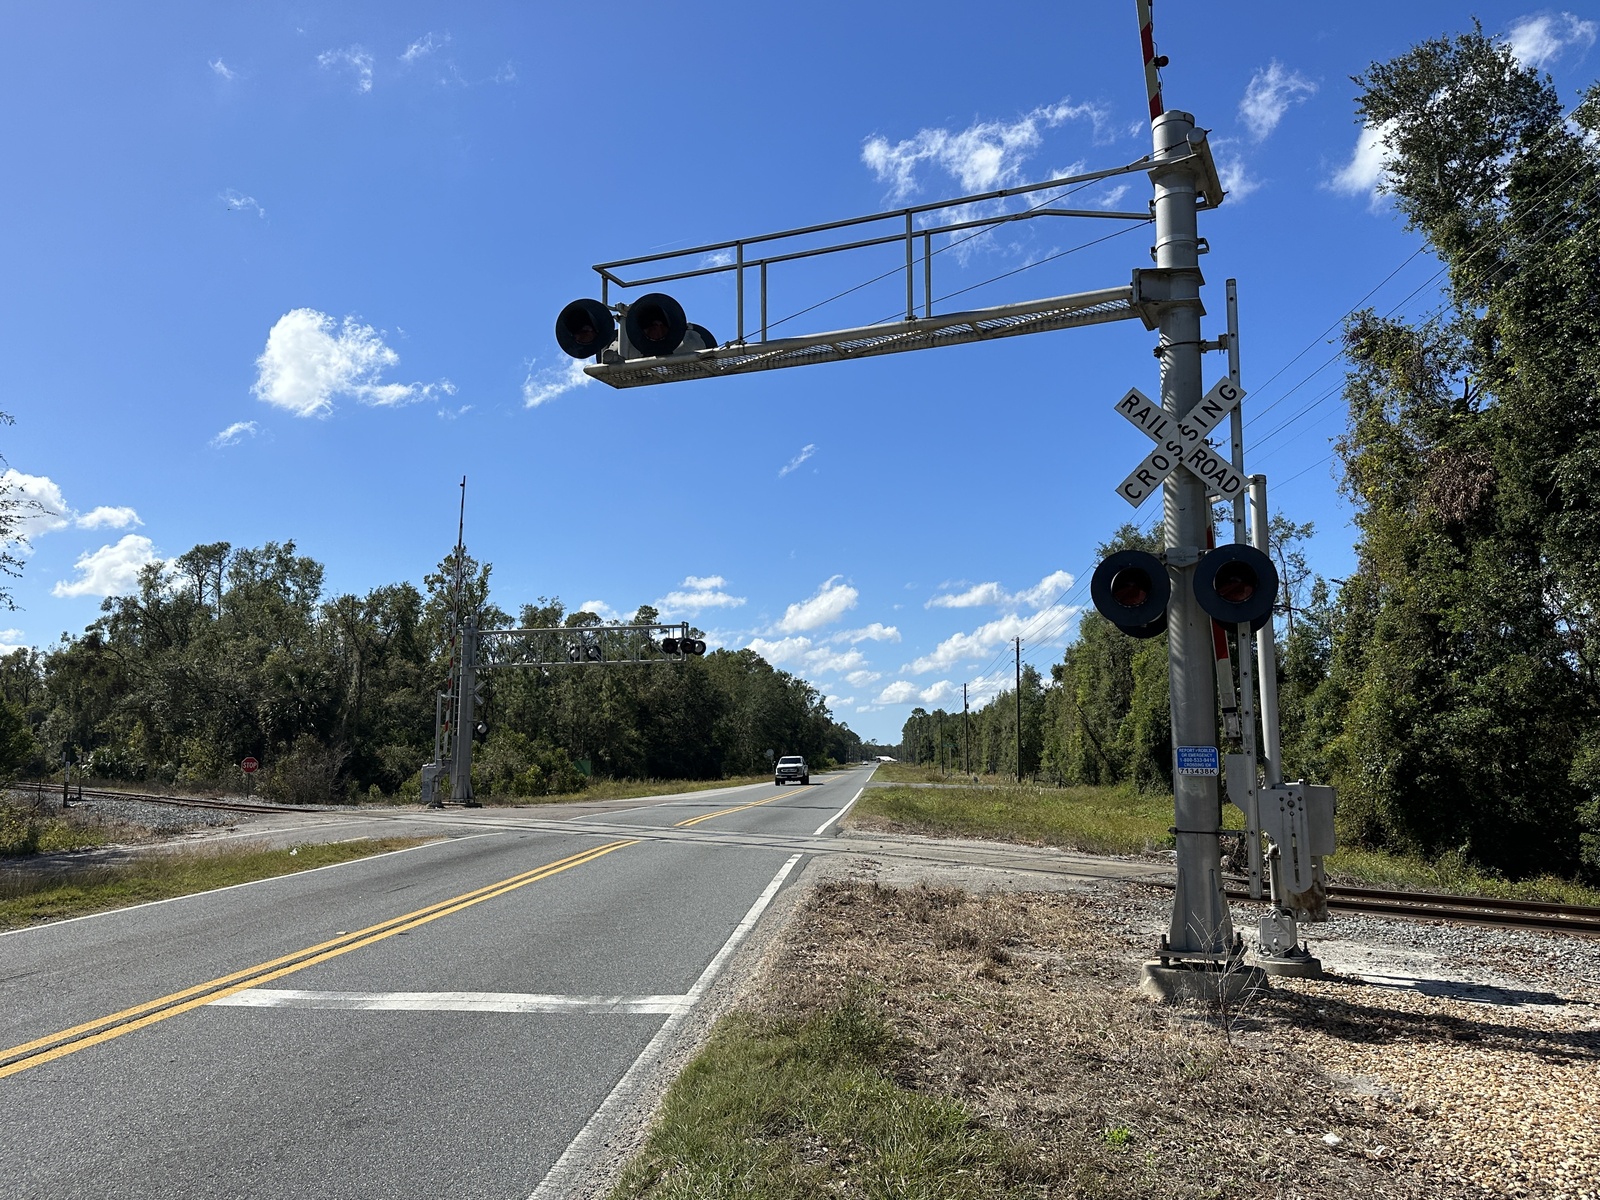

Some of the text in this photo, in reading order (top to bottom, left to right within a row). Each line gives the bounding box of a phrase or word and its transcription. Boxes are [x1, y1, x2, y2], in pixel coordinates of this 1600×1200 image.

[1121, 394, 1241, 494] RAIL ROAD
[1124, 384, 1237, 499] CROSSING
